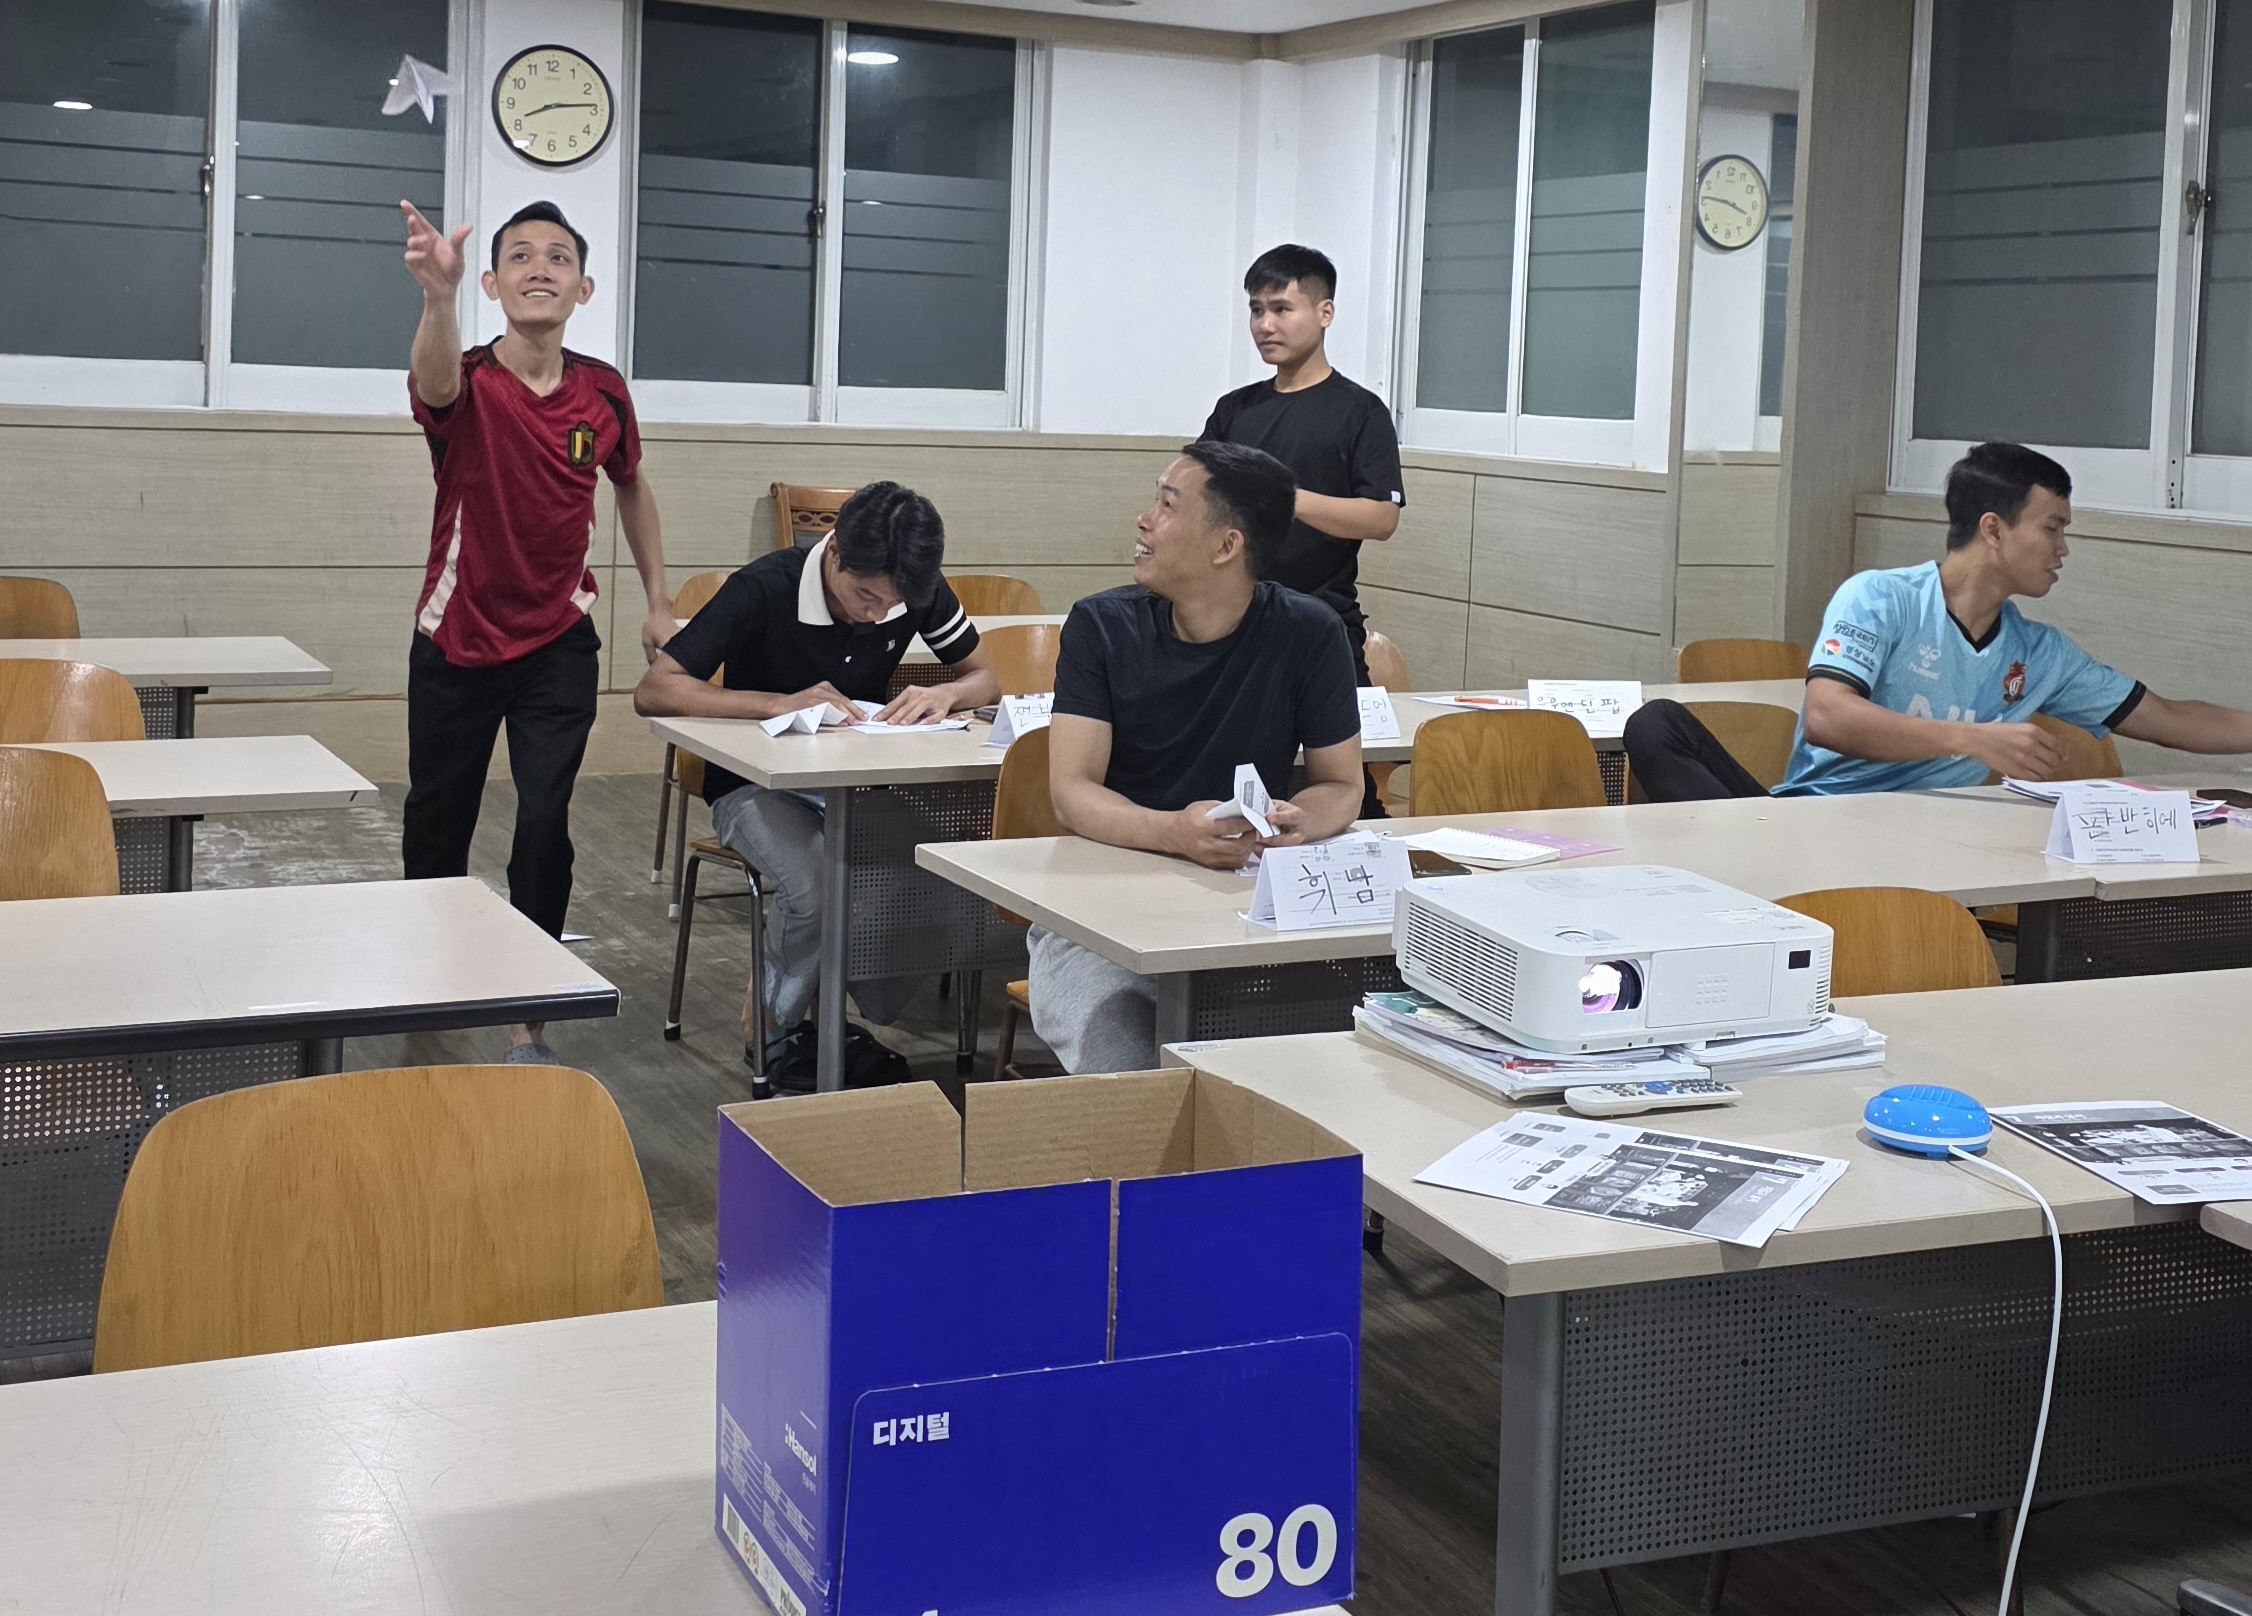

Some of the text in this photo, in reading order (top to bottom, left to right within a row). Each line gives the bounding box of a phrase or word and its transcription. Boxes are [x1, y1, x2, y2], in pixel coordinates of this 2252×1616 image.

[527, 63, 538, 75] 11
[546, 60, 560, 72] 12
[569, 68, 576, 80] 1
[512, 77, 526, 90] 10
[583, 82, 593, 95] 2
[506, 97, 516, 109] 9
[589, 103, 598, 116] 3
[513, 118, 523, 132] 8
[582, 123, 591, 136] 4
[528, 133, 538, 146] 7
[547, 139, 557, 152] 6
[568, 135, 577, 148] 5
[873, 1411, 950, 1447] 디지털
[1216, 1503, 1338, 1598] 80
